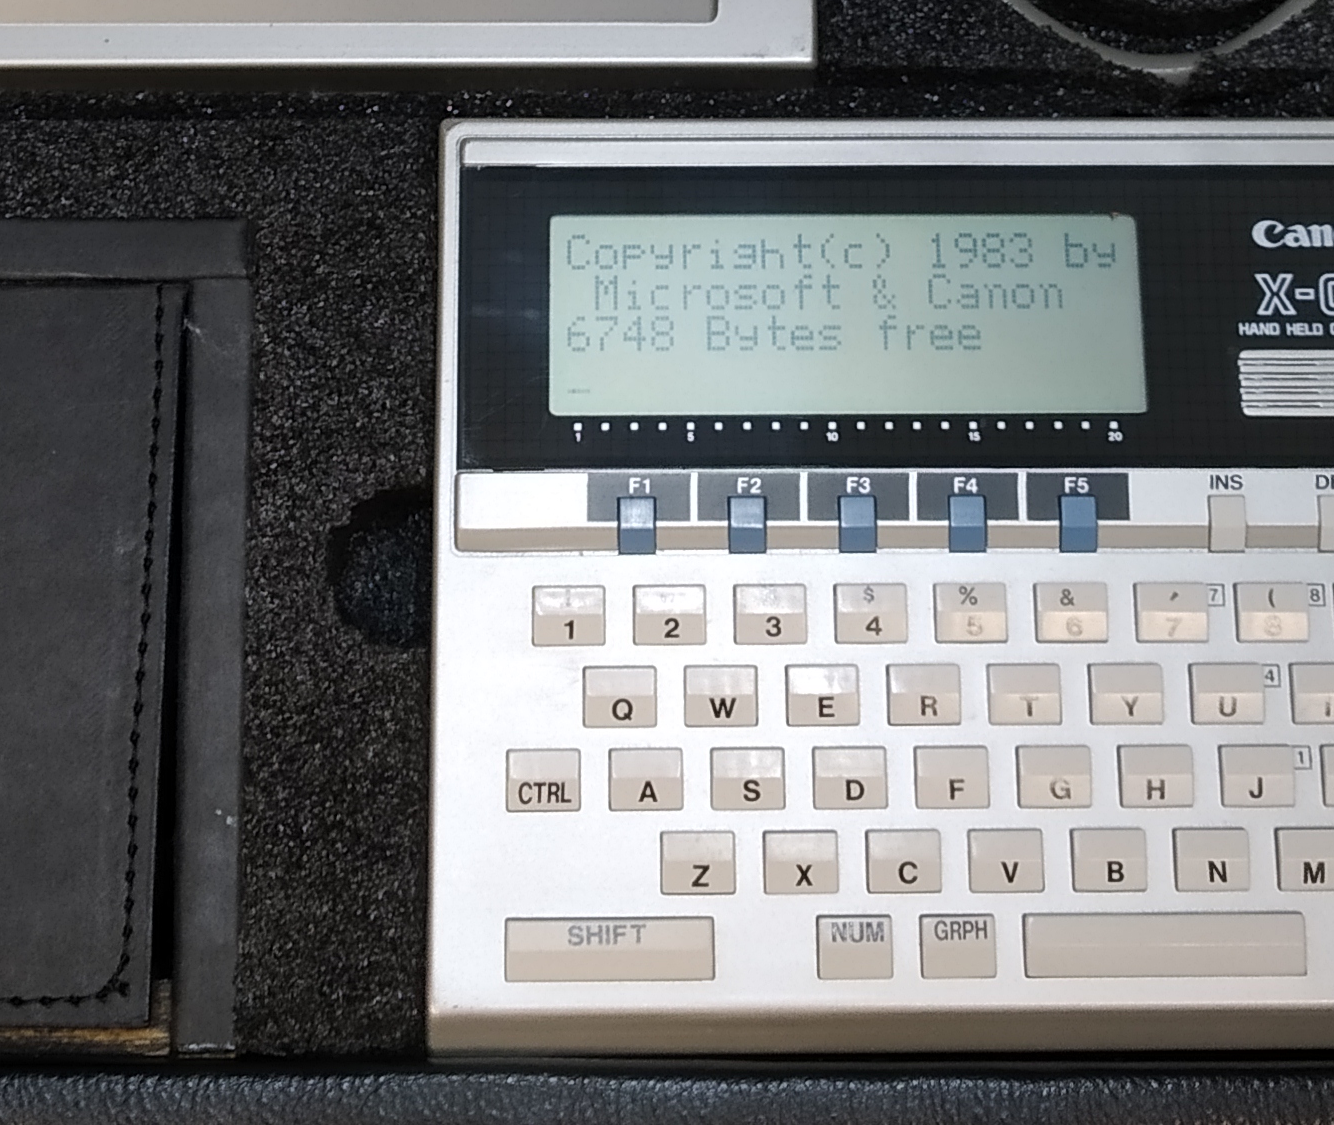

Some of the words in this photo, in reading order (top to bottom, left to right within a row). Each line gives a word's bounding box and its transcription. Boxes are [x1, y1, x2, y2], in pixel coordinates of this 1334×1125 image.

[567, 233, 890, 270] Copyright(c)
[931, 233, 1034, 269] 1983
[1064, 233, 1116, 269] by
[595, 274, 840, 310] Microsoft
[872, 274, 897, 309] &
[928, 274, 1063, 309] Canon
[567, 315, 674, 352] 6748
[707, 315, 842, 351] Bytes
[879, 313, 981, 350] free
[1238, 322, 1280, 336] HAND
[1286, 322, 1323, 336] HELD
[575, 433, 581, 443] 1
[687, 432, 694, 442] 5
[826, 432, 839, 442] 10
[968, 432, 981, 442] 15
[1108, 432, 1123, 441] 20
[629, 478, 651, 493] F1
[737, 478, 762, 493] F2
[846, 477, 871, 493] F3
[953, 477, 978, 493] F4
[1064, 477, 1089, 493] F5
[1209, 474, 1244, 490] INS
[959, 586, 978, 605] %
[1060, 588, 1075, 607] &
[1208, 588, 1219, 602] 7
[1268, 588, 1276, 608] (
[1310, 588, 1321, 602] 8
[564, 620, 575, 640] 1
[664, 618, 680, 638] 2
[766, 616, 782, 637] 3
[866, 616, 882, 636] 4
[966, 616, 983, 636] 5
[1066, 616, 1083, 636] 6
[1264, 669, 1275, 683] 4
[612, 698, 633, 721] Q
[709, 698, 736, 718] W
[818, 696, 835, 717] E
[920, 695, 938, 716] R
[1020, 696, 1038, 717] T
[1121, 696, 1139, 717] Y
[1219, 696, 1237, 717] U
[1298, 751, 1305, 764] 1
[518, 782, 572, 805] CTRL
[638, 781, 658, 803] A
[743, 779, 761, 802] S
[845, 779, 865, 801] D
[949, 778, 965, 800] F
[1050, 777, 1071, 800] G
[1147, 778, 1165, 800] H
[1248, 777, 1263, 799] J
[691, 864, 710, 887] Z
[795, 864, 813, 886] X
[898, 861, 918, 884] C
[1001, 861, 1019, 883] V
[1107, 861, 1124, 883] B
[1208, 861, 1227, 883] N
[1303, 861, 1325, 884] M
[567, 924, 646, 946] SHIFT
[831, 921, 885, 943] NUM
[934, 920, 988, 941] GRPH
